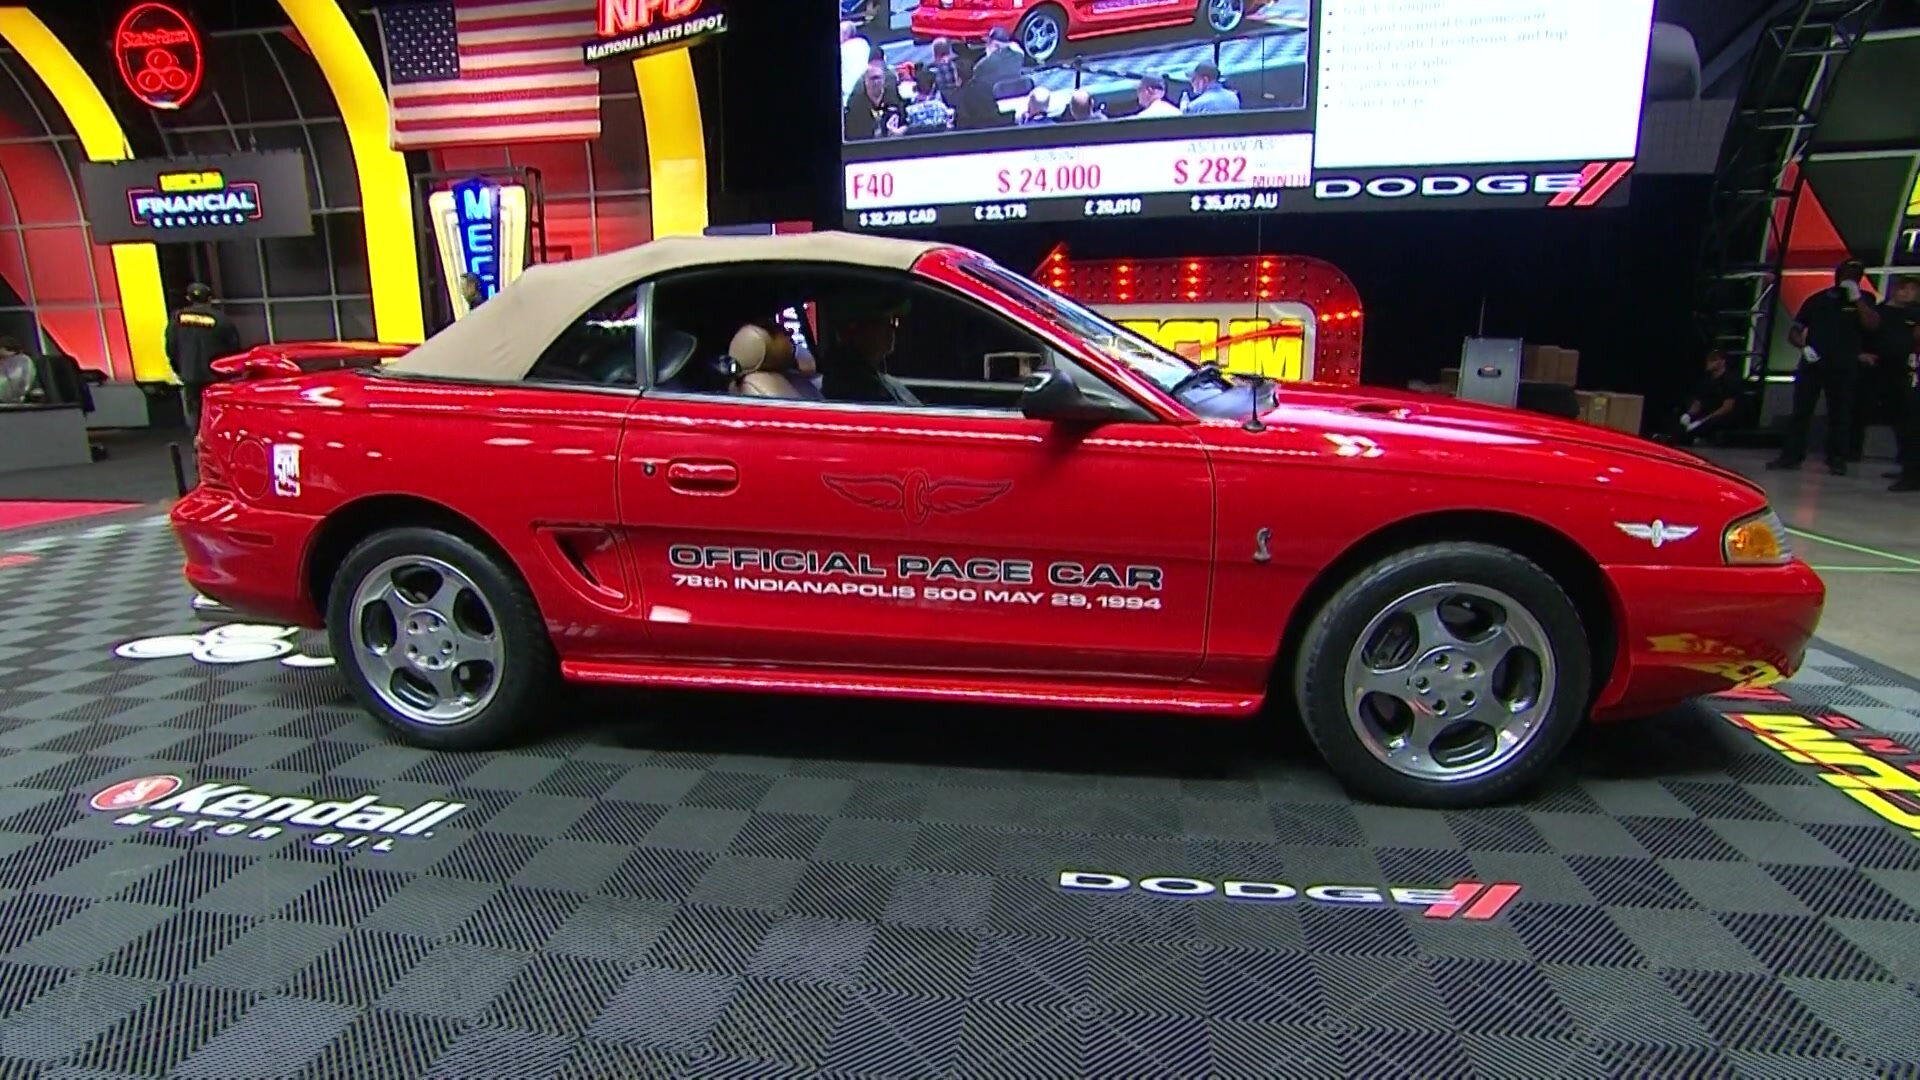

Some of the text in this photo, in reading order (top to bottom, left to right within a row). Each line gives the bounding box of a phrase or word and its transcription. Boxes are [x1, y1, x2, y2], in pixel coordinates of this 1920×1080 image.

[586, 14, 724, 60] NATIONAL PARTS DEPOT
[1018, 163, 1102, 194] 24,000
[1197, 156, 1248, 185] 282
[853, 171, 894, 200] F40
[1314, 173, 1582, 199] DODGE
[135, 191, 256, 215] FINANCIAL
[1253, 193, 1278, 209] AU
[152, 213, 244, 228] SERVICES
[908, 208, 937, 224] CAD
[668, 543, 1164, 591] OFFICIAL PACE CAR
[671, 573, 728, 589] 78th
[734, 577, 916, 599] INDIANAPOLIS
[923, 586, 977, 602] 500
[984, 589, 1045, 605] MAY
[113, 812, 395, 853] MOTOR OIL
[1059, 870, 1461, 906] DODGE
